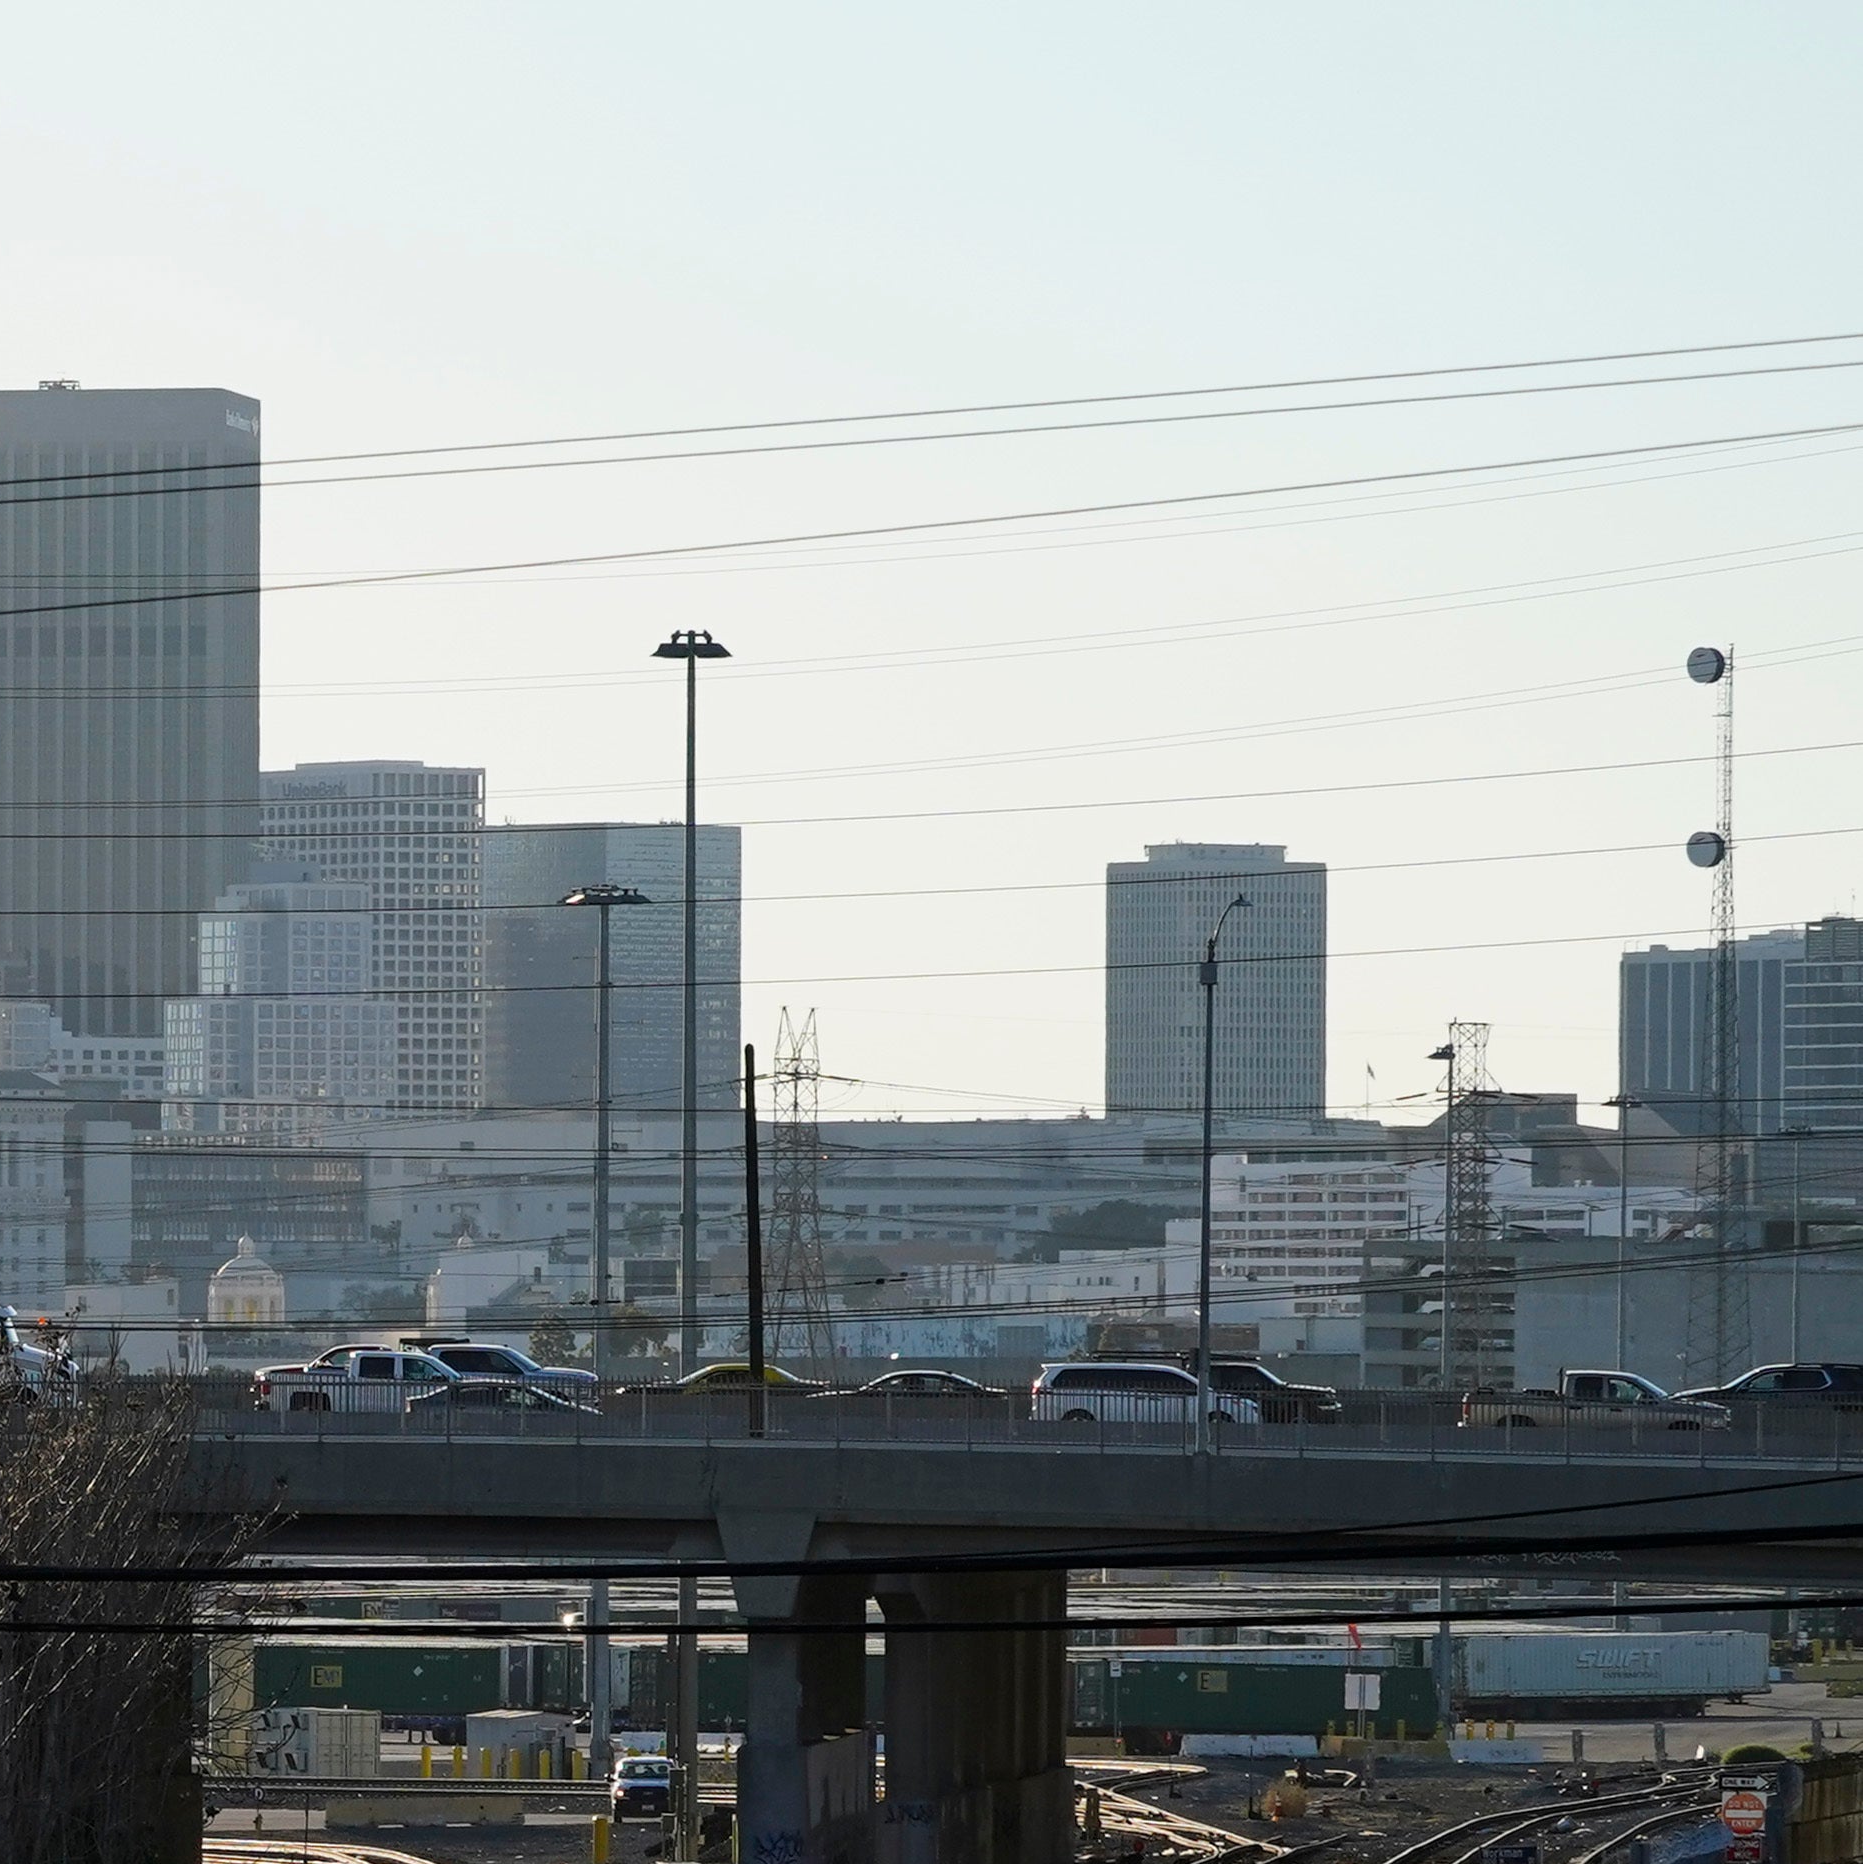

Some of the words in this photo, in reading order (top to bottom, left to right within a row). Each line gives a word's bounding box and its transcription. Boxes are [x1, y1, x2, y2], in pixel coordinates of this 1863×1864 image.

[282, 780, 347, 798] UnionBank
[1575, 1647, 1662, 1669] SWIFT
[1723, 1778, 1738, 1786] ONE
[1740, 1778, 1755, 1786] WAY
[1728, 1800, 1741, 1809] DO
[1742, 1800, 1760, 1809] NOT
[1731, 1819, 1757, 1828] ENTER
